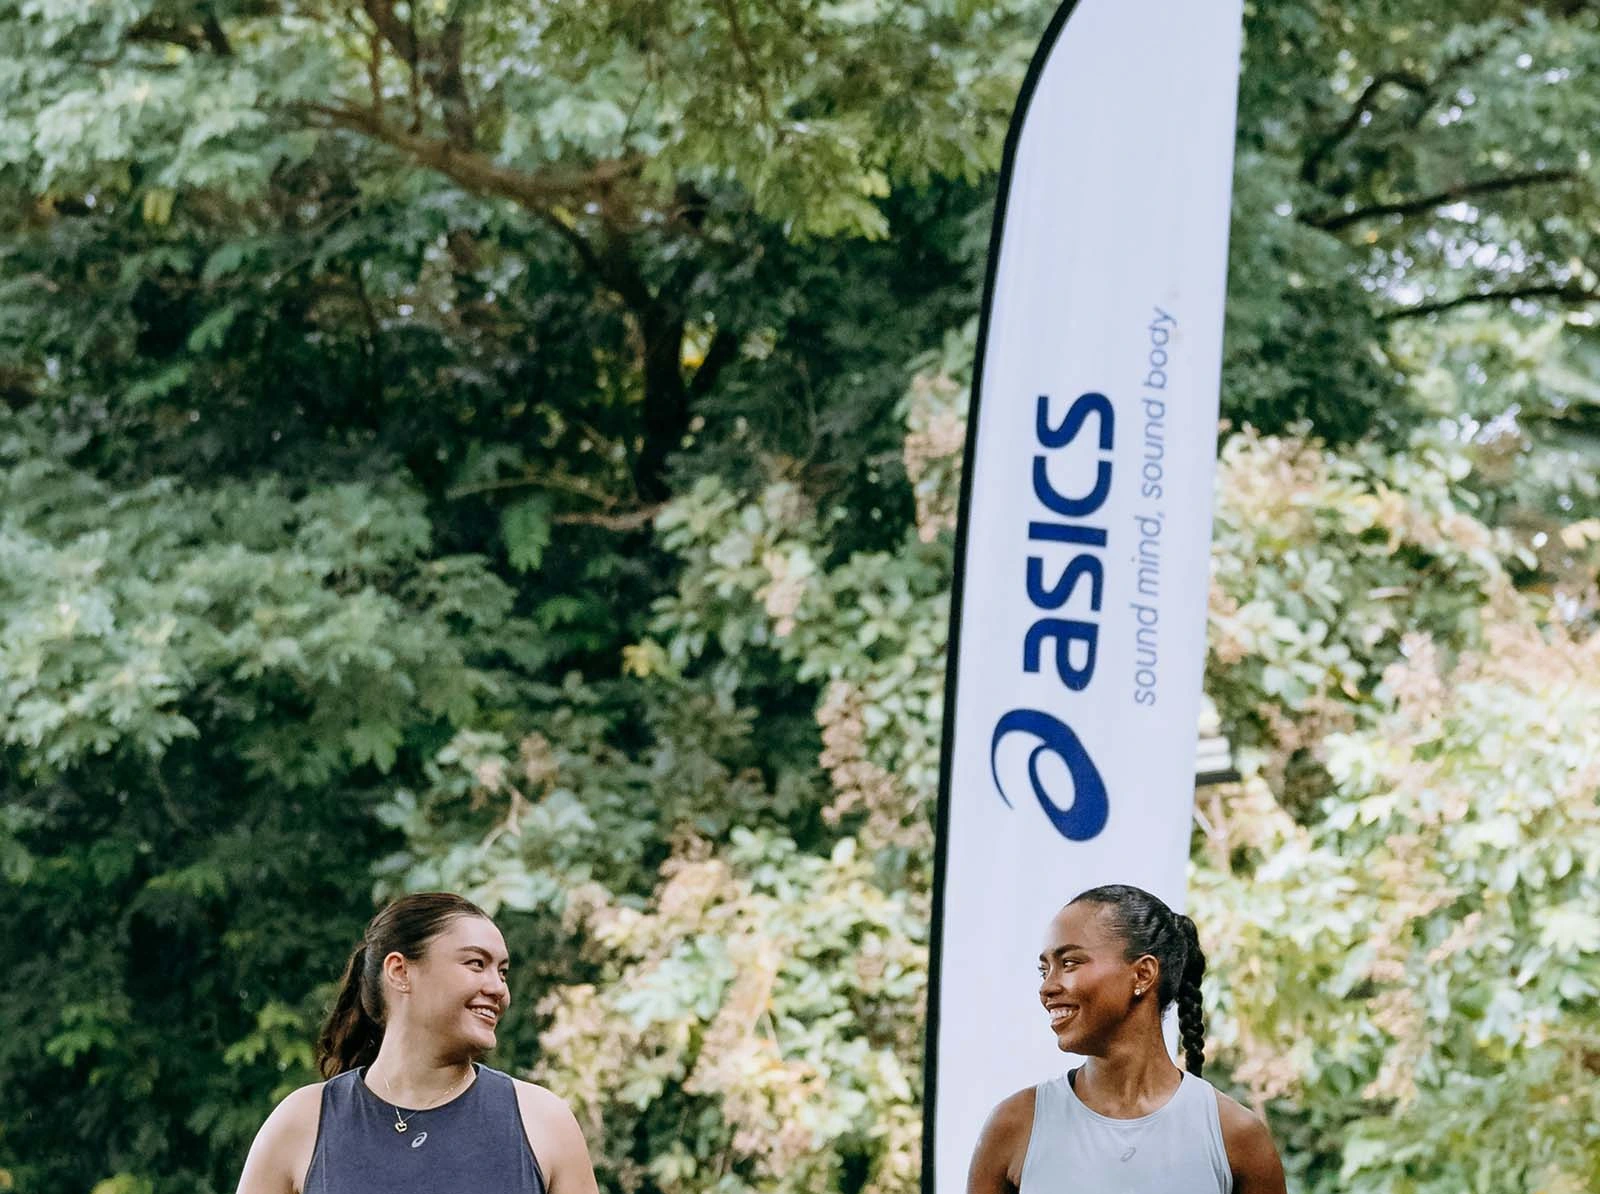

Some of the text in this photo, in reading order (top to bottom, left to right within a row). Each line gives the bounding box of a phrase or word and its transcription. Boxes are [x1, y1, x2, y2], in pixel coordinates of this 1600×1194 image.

[1129, 306, 1178, 706] sound mind, sound body
